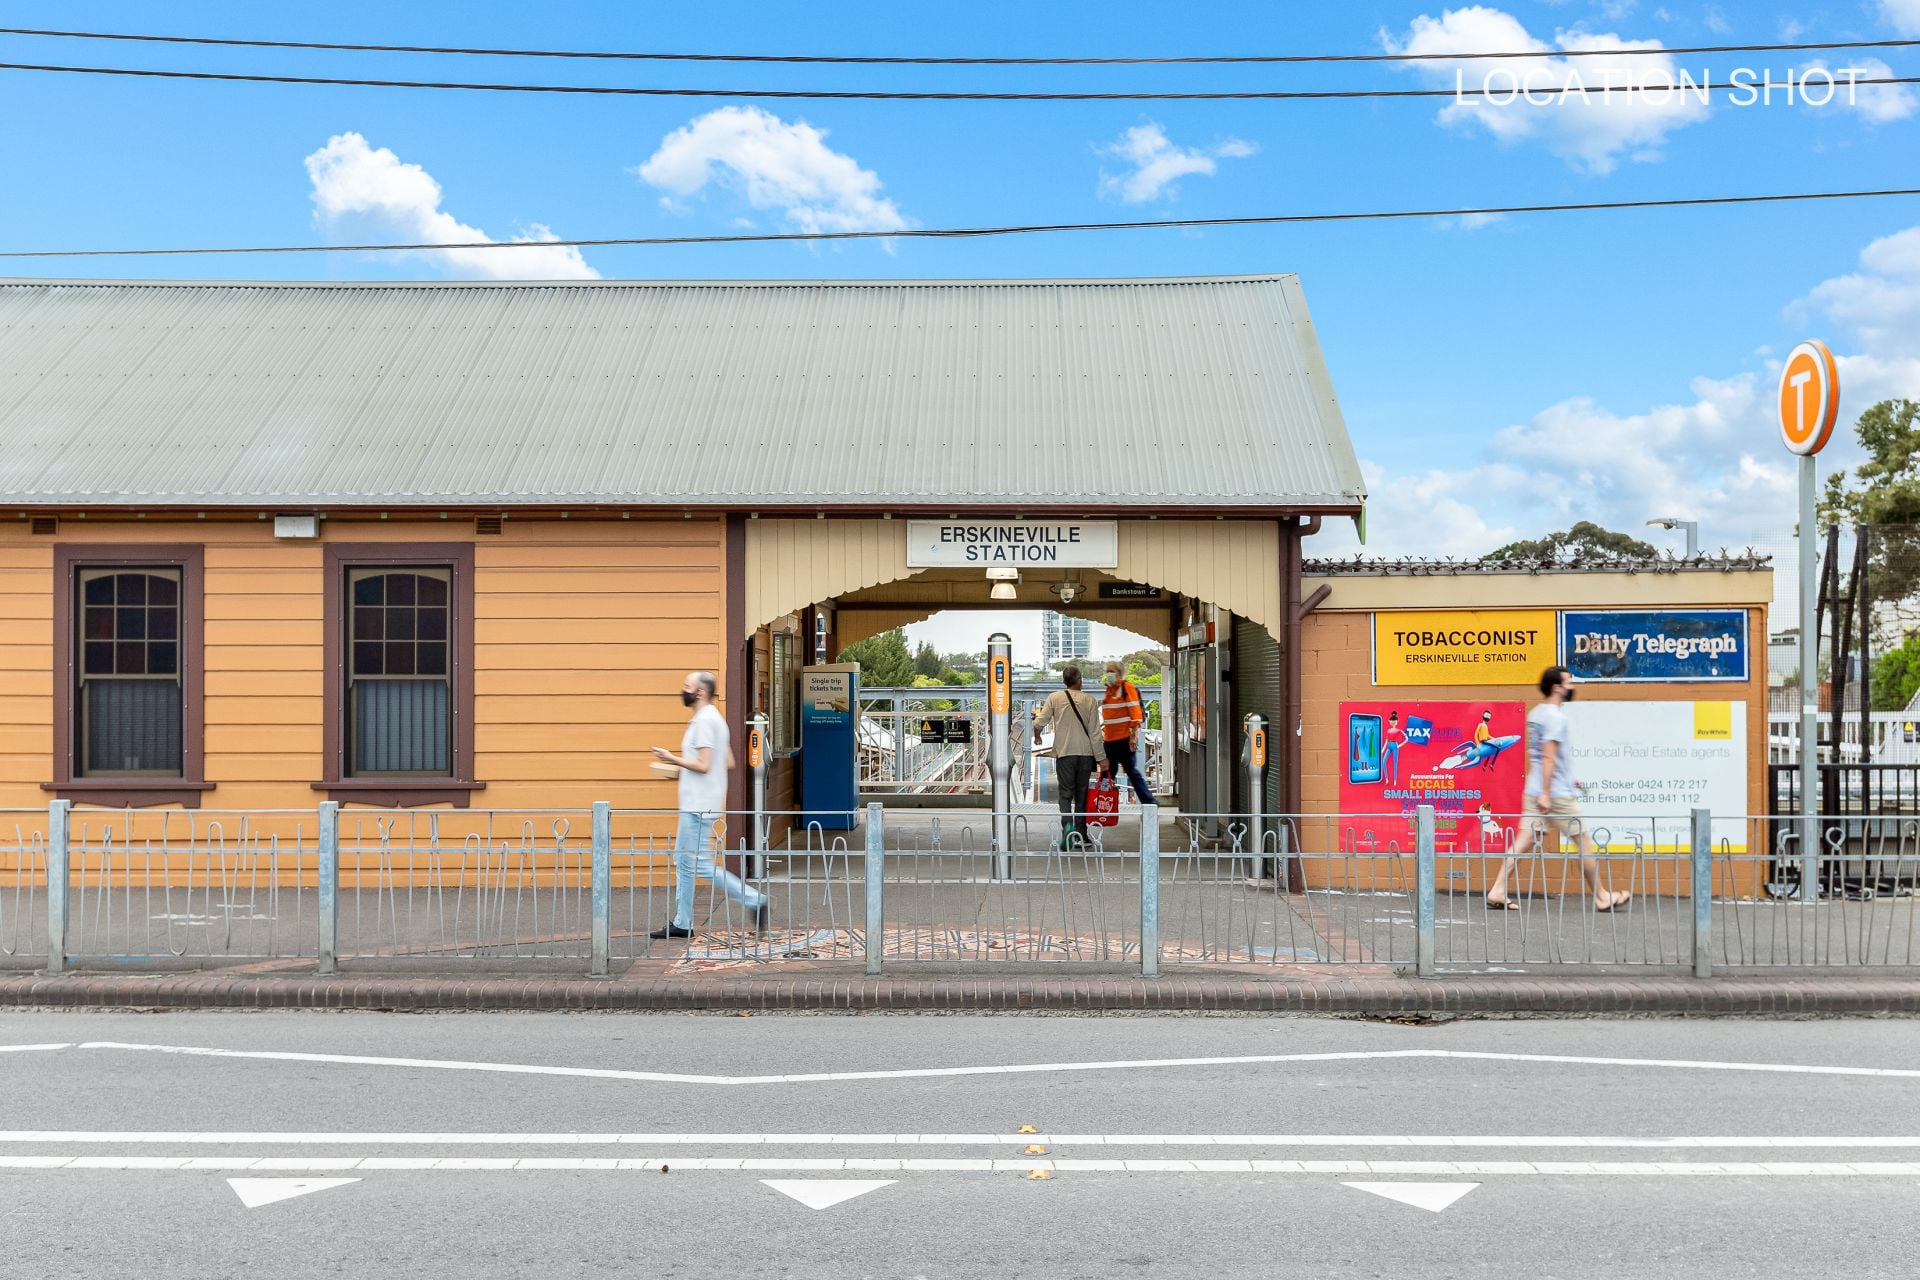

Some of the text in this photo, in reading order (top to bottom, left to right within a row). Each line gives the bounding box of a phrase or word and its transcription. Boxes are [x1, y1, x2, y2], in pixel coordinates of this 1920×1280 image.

[940, 526, 1081, 543] ERSKINEVILLE
[965, 545, 1056, 561] STATION
[1393, 630, 1538, 647] TOBACCONIST
[1573, 633, 1738, 659] Daily Telegraph
[1405, 653, 1527, 663] ERSKINEVILLE STATION
[1406, 727, 1431, 738] TAX
[1594, 745, 1620, 758] local
[1623, 746, 1649, 758] Real
[1652, 746, 1688, 758] Estate
[1690, 748, 1731, 760] agents
[1409, 779, 1455, 789] LOCALS
[1600, 779, 1635, 790] Stoker
[1637, 779, 1663, 790] 0424
[1667, 779, 1687, 790] 172
[1688, 779, 1708, 790] 217
[1383, 789, 1482, 799] SMALL BUSINESS
[1598, 793, 1627, 804] Ersan
[1629, 793, 1656, 804] 0423
[1658, 793, 1677, 804] 941
[1682, 793, 1700, 804] 112
